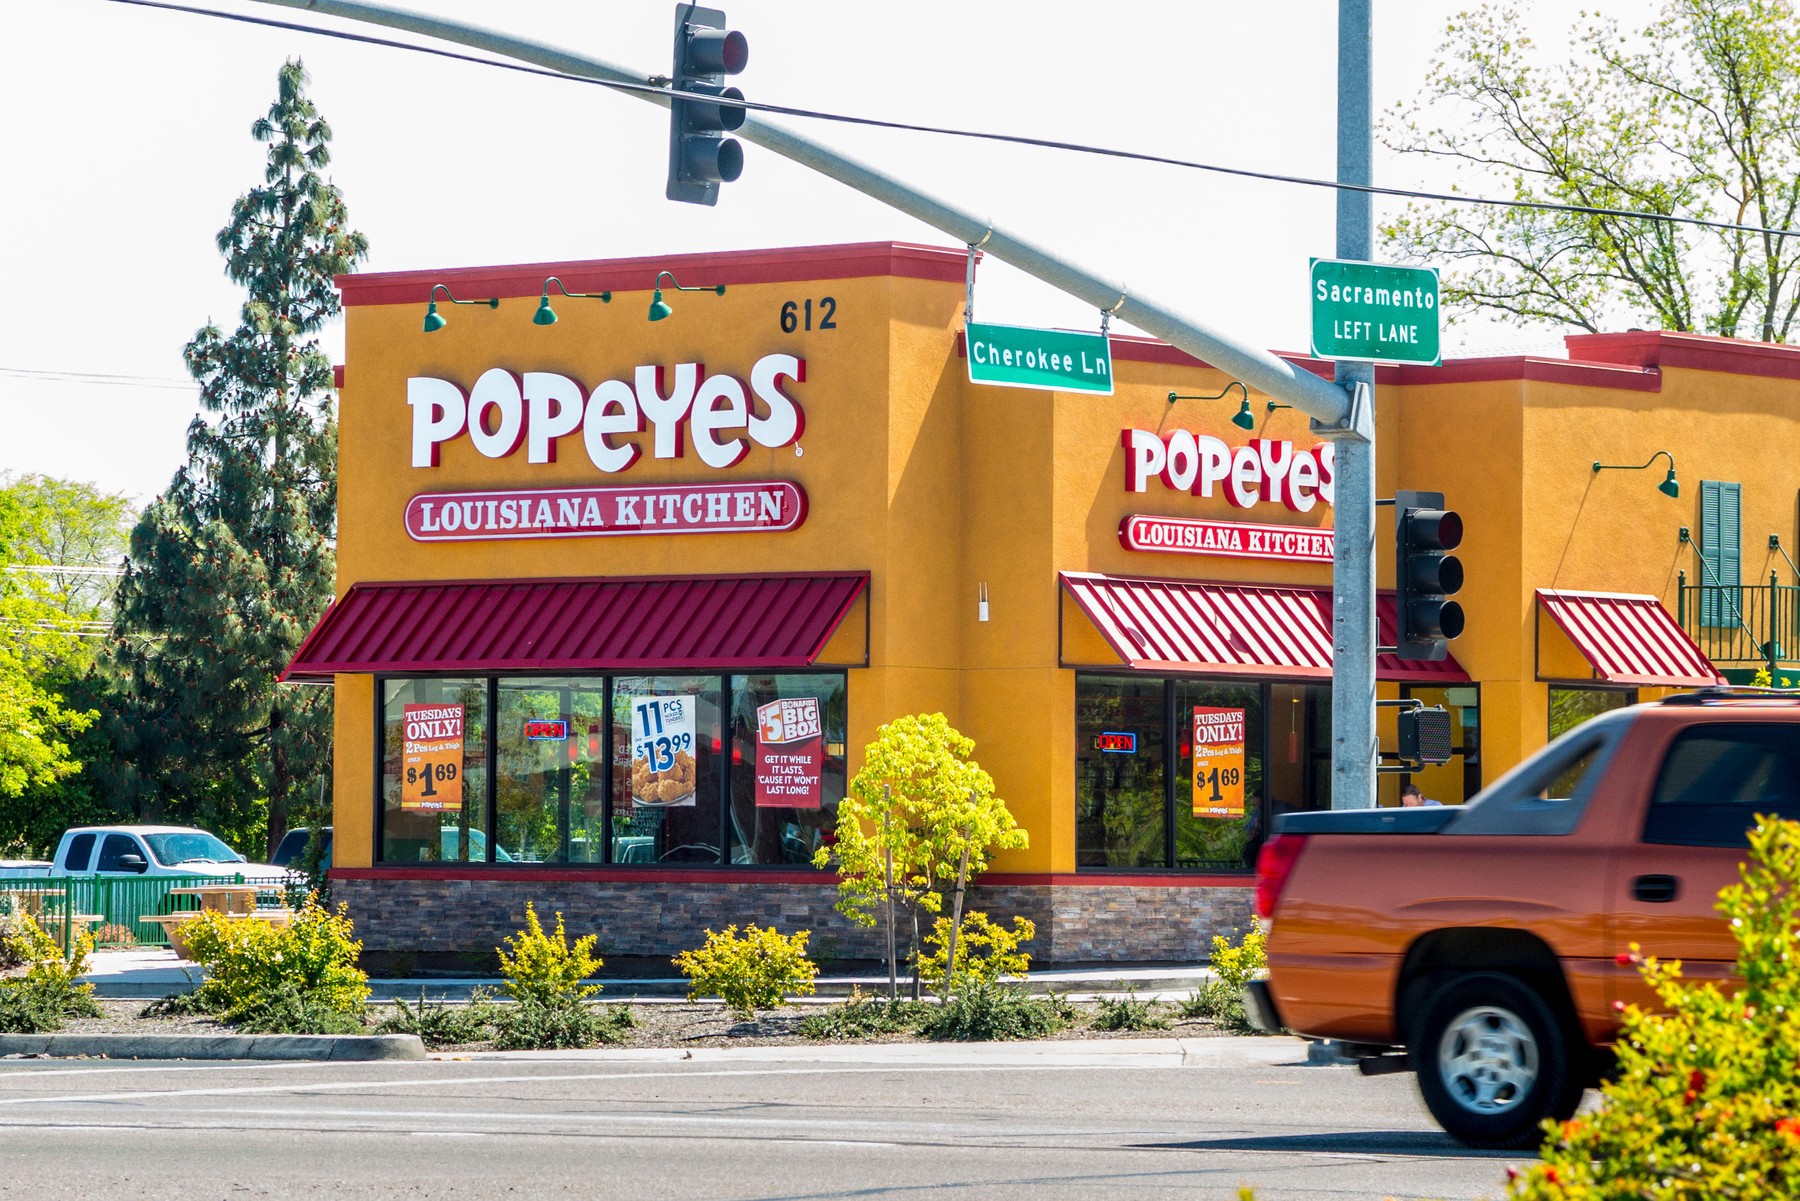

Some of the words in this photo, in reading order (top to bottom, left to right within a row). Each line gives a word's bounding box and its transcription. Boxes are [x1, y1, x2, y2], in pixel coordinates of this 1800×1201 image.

[1316, 279, 1434, 309] Sacramento
[780, 296, 836, 333] 612
[1334, 320, 1371, 340] LEFT
[1379, 323, 1419, 344] LANE
[973, 341, 1073, 371] Cherokee
[1081, 351, 1107, 375] Ln
[420, 495, 604, 532] LOUISIANA
[615, 490, 784, 526] KITCHEN
[1138, 523, 1242, 551] LOUISIANA
[405, 707, 461, 722] TUESDAYS
[637, 701, 663, 737] 11
[663, 699, 682, 713] PCS
[783, 706, 817, 724] BIG
[1195, 712, 1243, 725] TUESDAYS
[407, 719, 461, 740] ONLY!
[524, 722, 564, 737] OPEN
[784, 720, 819, 740] BOX
[1196, 723, 1243, 743] ONLY!
[406, 741, 413, 754] 2
[413, 743, 428, 753] Pcs
[1099, 735, 1133, 750] OPEN
[1195, 745, 1202, 757] 2
[1202, 747, 1215, 757] Pcs
[764, 755, 779, 764] GET
[780, 755, 788, 764] IT
[789, 755, 812, 764] WHILE
[772, 765, 780, 774] IT
[780, 766, 805, 775] LASTS,
[758, 775, 783, 784] 'CAUSE
[784, 775, 792, 784] IT
[793, 775, 819, 785] WON'T
[766, 786, 785, 794] LAST
[786, 786, 810, 795] LONG!
